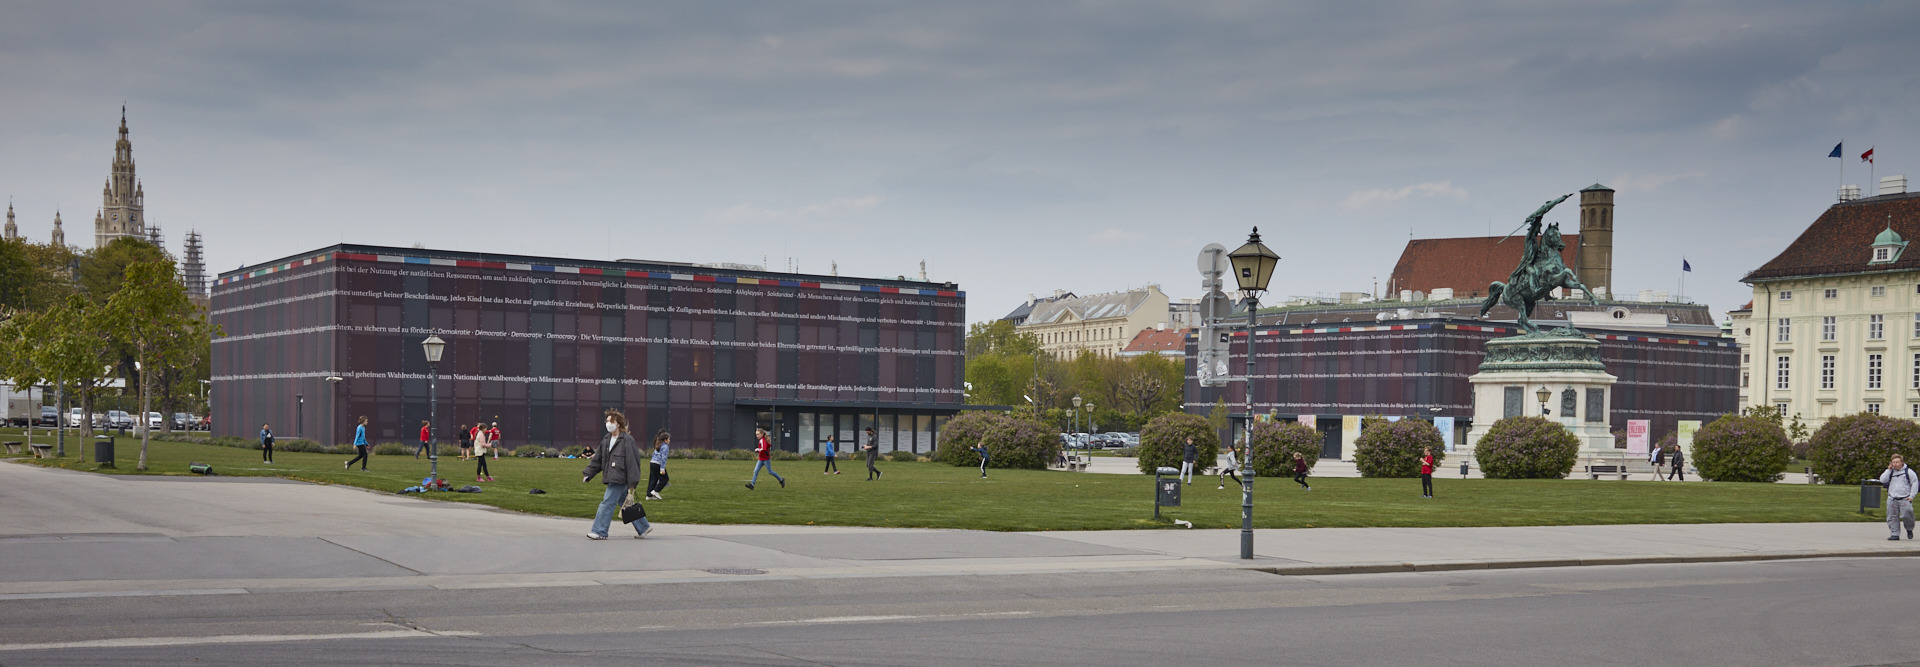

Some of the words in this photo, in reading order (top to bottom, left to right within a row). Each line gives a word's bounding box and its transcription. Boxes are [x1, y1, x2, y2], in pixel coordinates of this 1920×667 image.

[370, 267, 398, 276] Nutzung
[410, 270, 444, 278] natürlichen
[446, 272, 482, 280] Ressourcen,
[508, 275, 542, 285] zukünftigen
[582, 280, 619, 289] bestmögliche
[620, 282, 659, 291] Lebensqualität
[668, 285, 703, 294] gewährleisten
[880, 297, 894, 305] gleich
[351, 290, 382, 299] unterliegt
[450, 294, 466, 302] Jedes
[533, 299, 564, 308] gewaltfreie
[596, 302, 628, 311] Körperliche
[827, 314, 866, 323] Misshandlungen
[592, 334, 634, 343] Vertragsstaaten
[356, 371, 386, 379] geheimen
[488, 375, 538, 383] wahlberechtigten
[595, 378, 617, 386] gewählt
